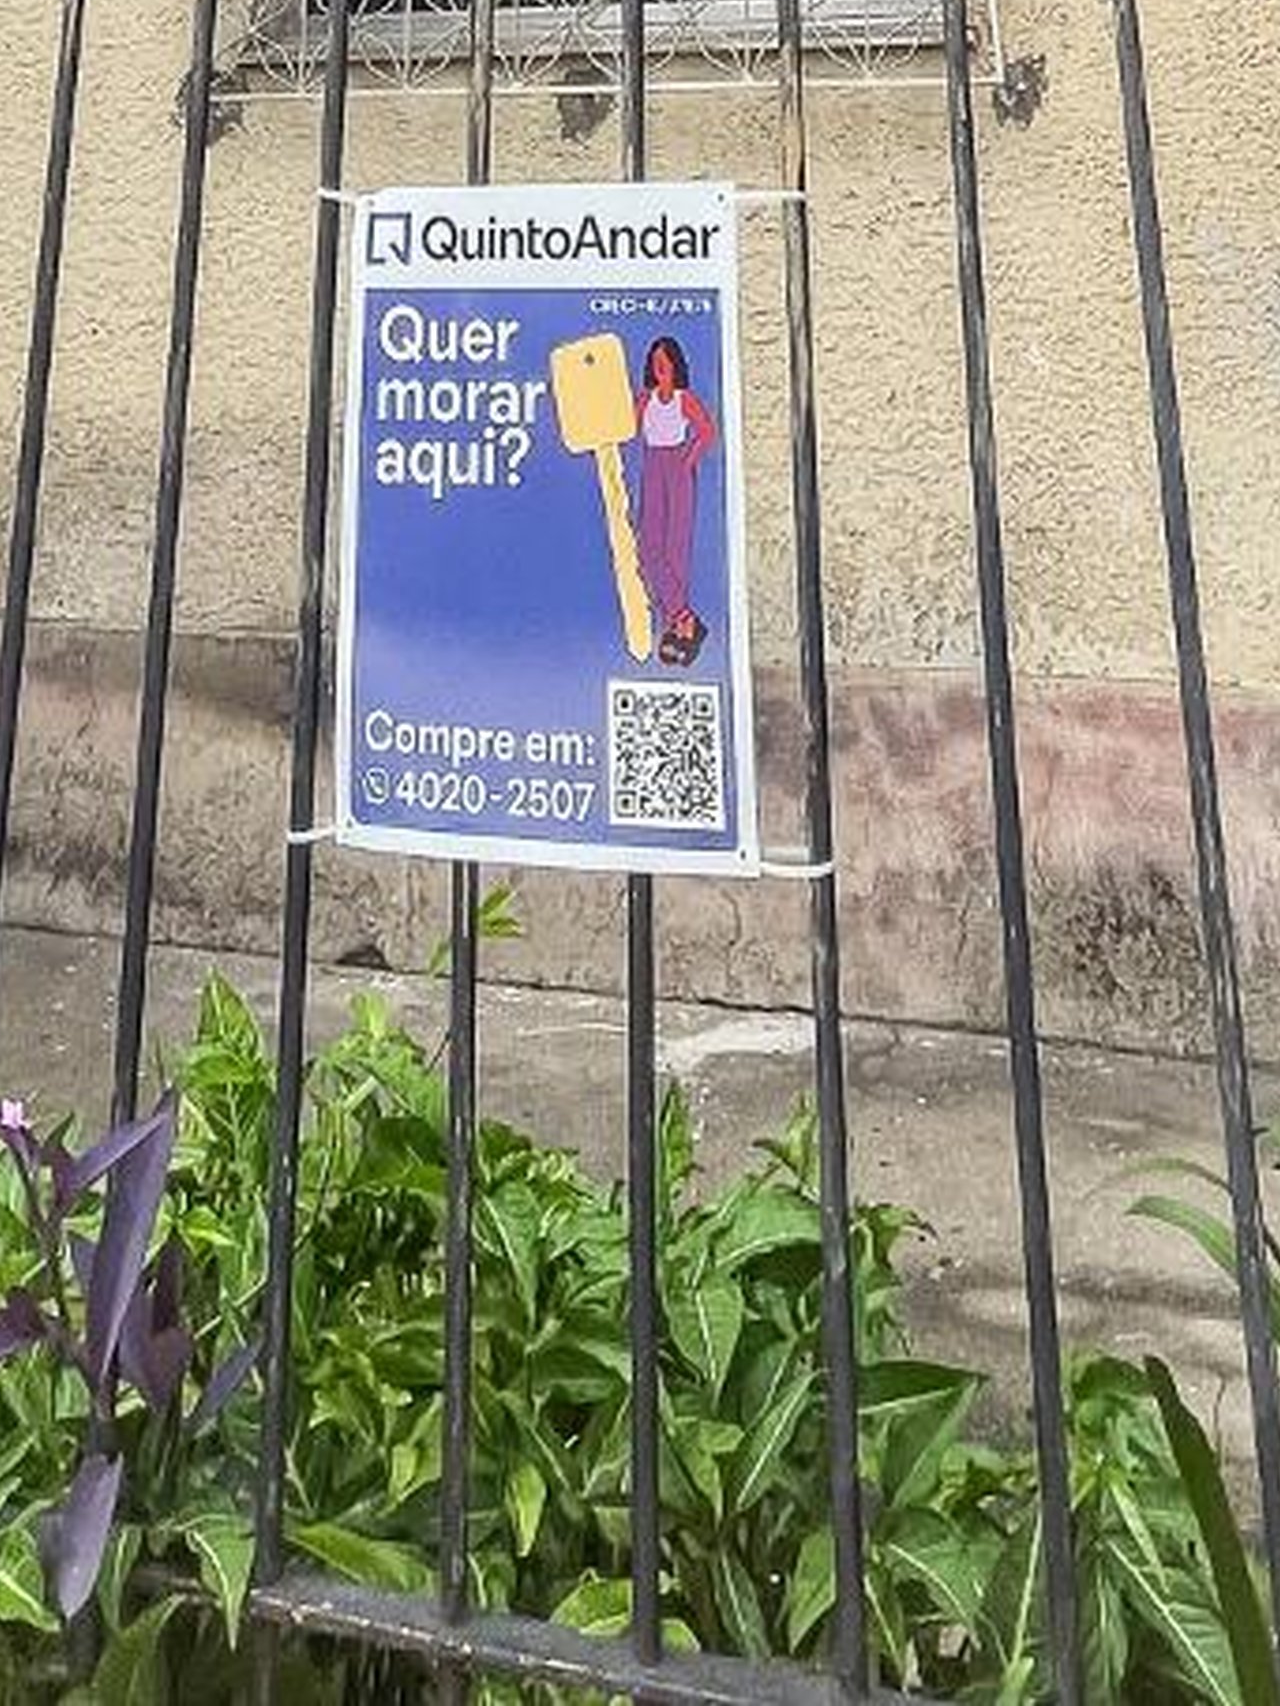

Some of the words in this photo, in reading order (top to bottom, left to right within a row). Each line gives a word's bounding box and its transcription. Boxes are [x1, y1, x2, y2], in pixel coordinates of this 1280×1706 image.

[421, 214, 720, 263] QuintoAndar
[380, 304, 520, 365] Quer
[376, 377, 547, 424] morar
[376, 426, 531, 500] aqui?
[365, 709, 515, 767] Compre
[526, 733, 596, 766] em:
